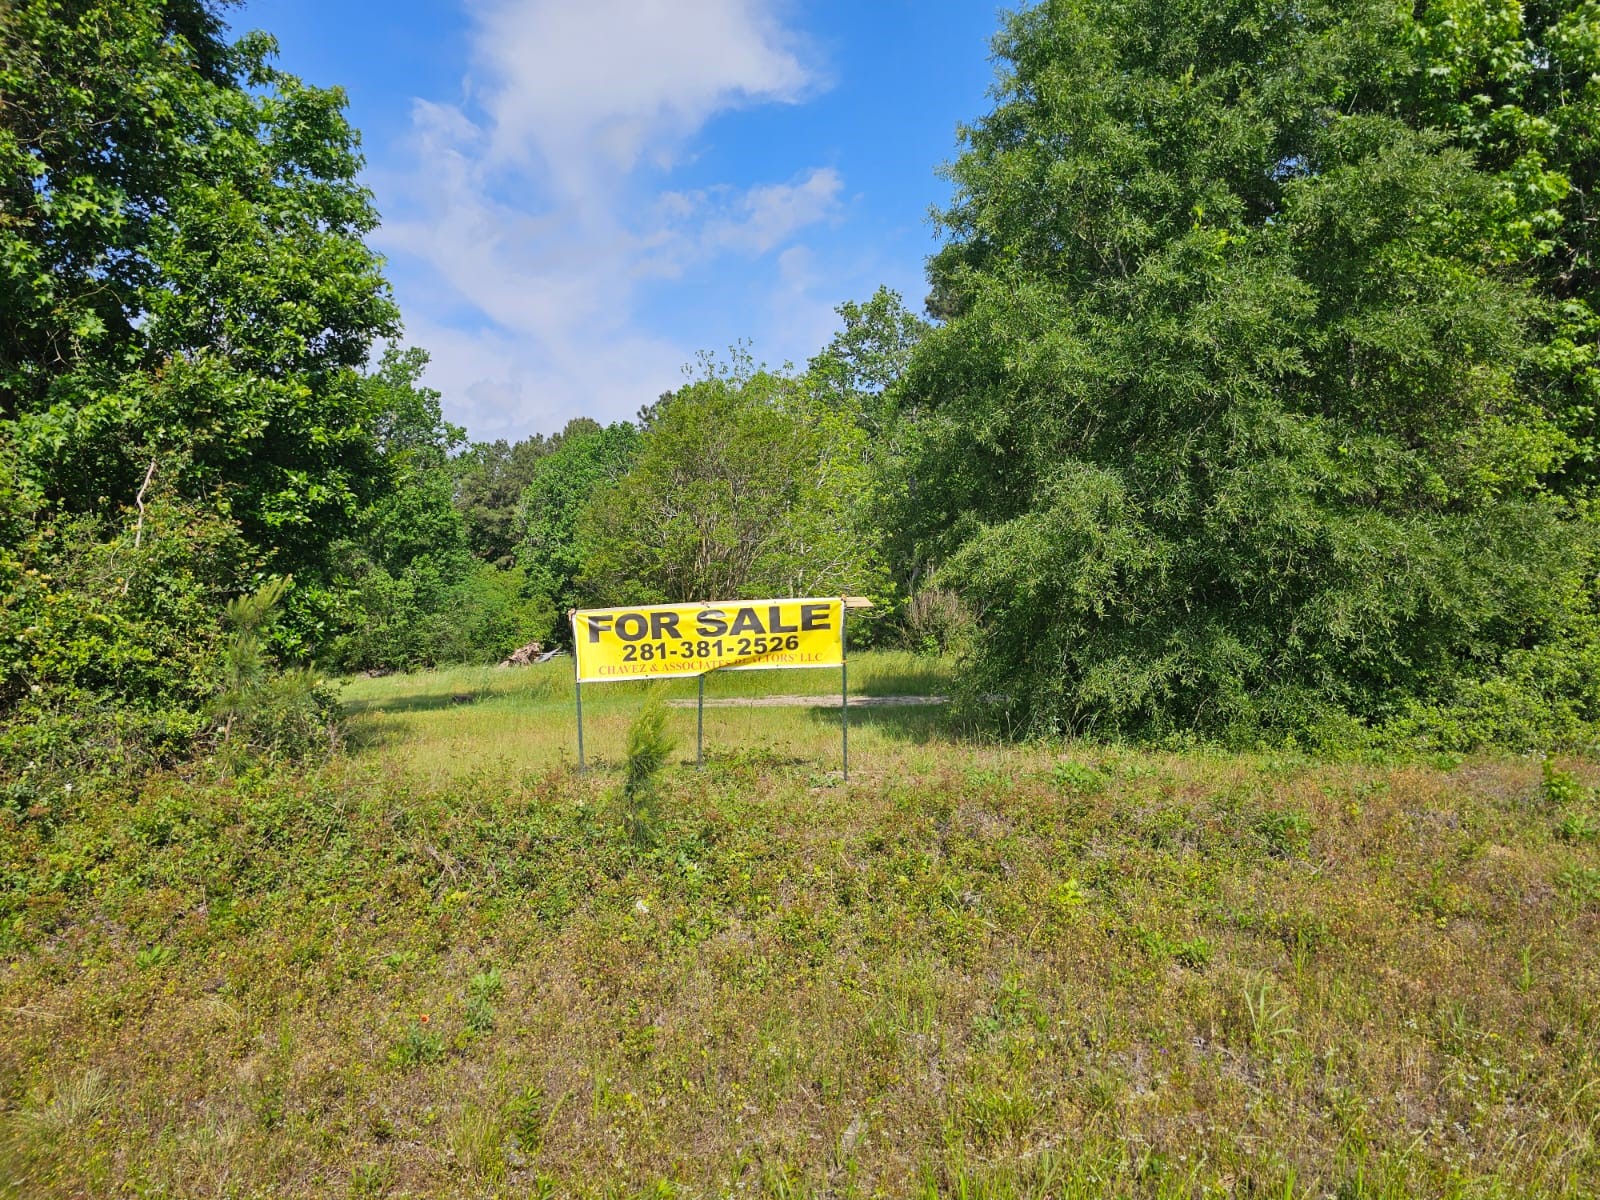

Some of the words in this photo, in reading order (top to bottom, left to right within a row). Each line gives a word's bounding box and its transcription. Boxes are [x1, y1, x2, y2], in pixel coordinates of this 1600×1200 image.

[587, 611, 682, 643] FOR
[696, 604, 831, 638] SALE
[622, 635, 799, 661] 281-381-2526
[598, 664, 647, 675] CHAVEZ
[649, 663, 659, 672] &
[800, 652, 823, 662] LLC
